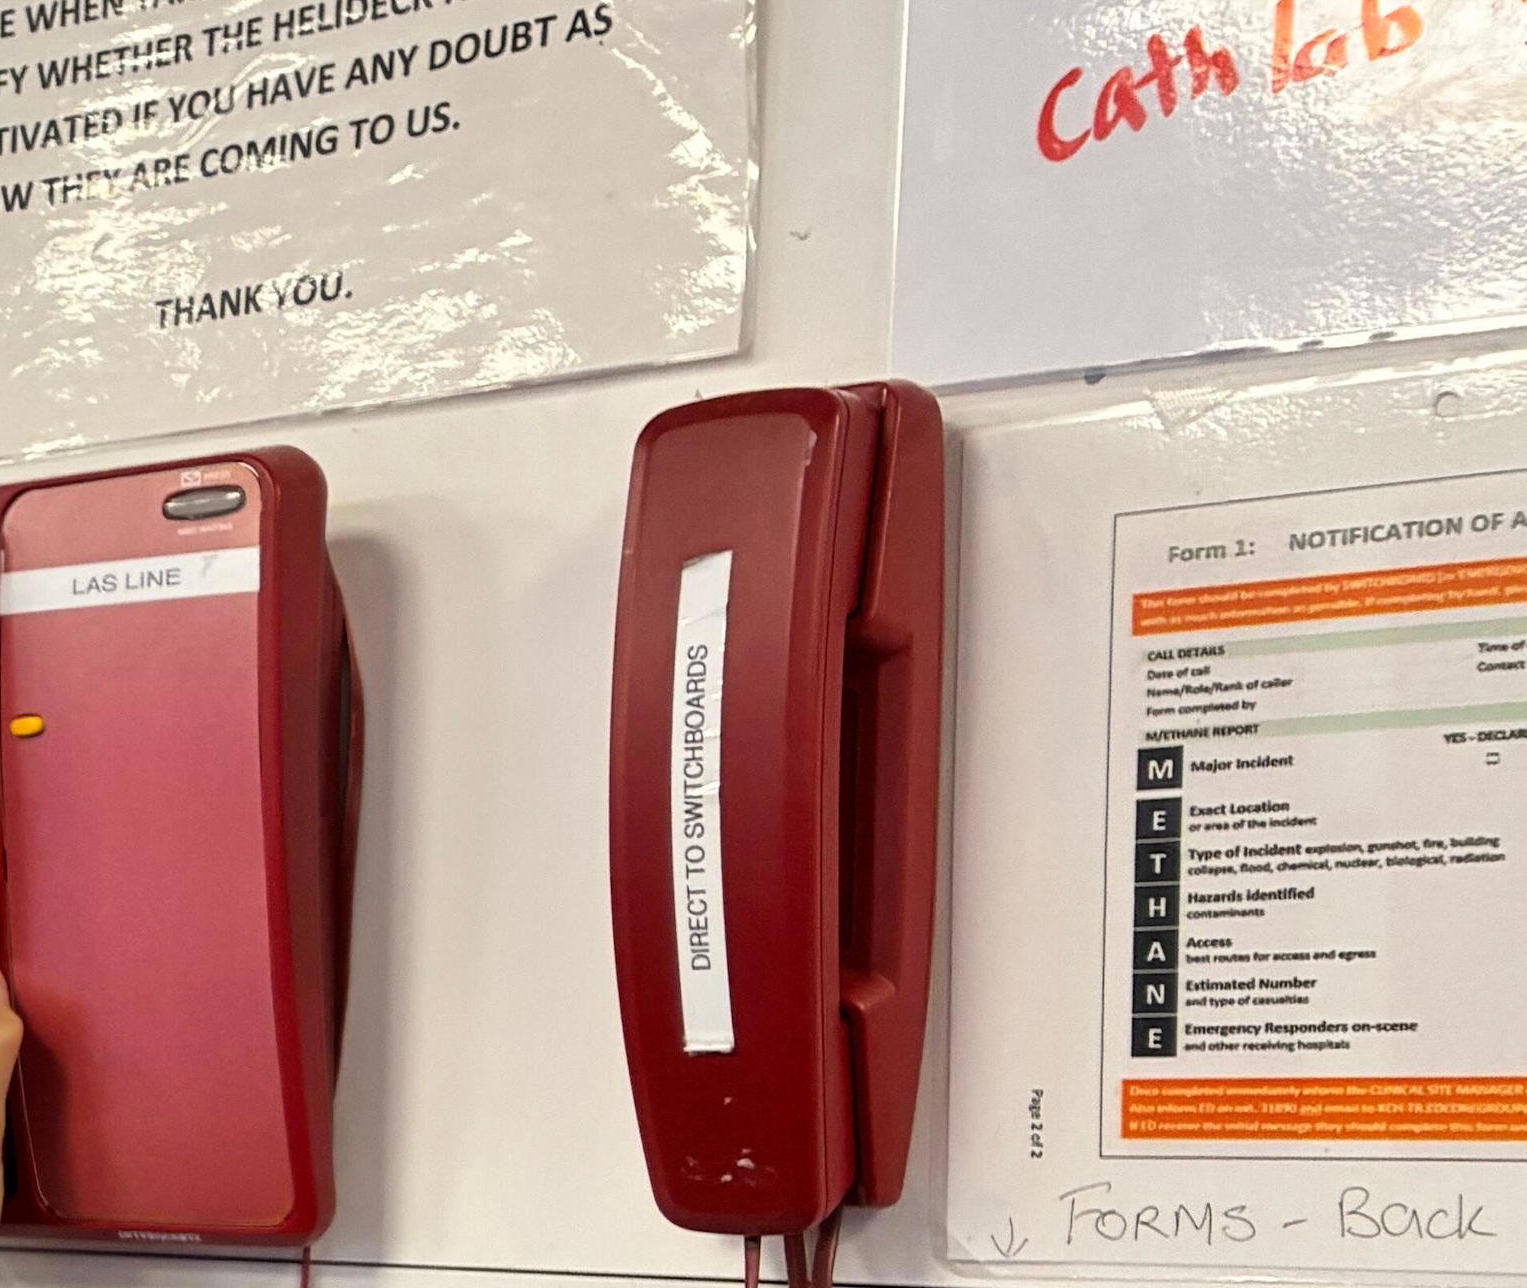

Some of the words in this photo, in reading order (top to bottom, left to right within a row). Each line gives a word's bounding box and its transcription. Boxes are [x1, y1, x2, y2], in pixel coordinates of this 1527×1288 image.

[37, 32, 194, 90] WHETHER
[202, 16, 264, 57] THE
[133, 99, 160, 130] IF
[168, 83, 237, 123] YOU
[246, 62, 336, 110] HAVE
[345, 45, 420, 90] ANY
[429, 14, 559, 72] DOUBT
[565, 3, 614, 42] AS
[1037, 25, 1240, 162] Cath
[1270, 0, 1425, 94] lab
[41, 167, 124, 207] THEY
[131, 153, 191, 189] ARE
[199, 123, 339, 178] COMING
[349, 113, 395, 151] TO
[406, 101, 461, 138] US.
[154, 283, 264, 329] THANK
[272, 271, 353, 309] YOU.
[1289, 516, 1464, 551] NOTIFICATION
[1470, 512, 1505, 534] OF
[1168, 545, 1227, 563] Form
[1234, 538, 1256, 557] 1:
[72, 573, 117, 596] LAS
[125, 567, 182, 591] LINE
[1147, 650, 1175, 662] CALL
[1177, 646, 1226, 660] DETAILS
[1478, 642, 1509, 653] Time
[1147, 669, 1174, 681] Date
[1176, 667, 1189, 678] of
[1191, 665, 1212, 678] call
[1477, 660, 1526, 673] Contact
[1147, 681, 1244, 699] Name/Role/Rank
[1246, 679, 1260, 690] of
[1260, 678, 1294, 690] caller
[1147, 706, 1176, 717] Form
[1178, 700, 1240, 715] completed
[1241, 700, 1257, 712] by
[684, 643, 709, 839] SWITCHBOARDS
[1145, 727, 1210, 743] M/ETHANE
[1212, 723, 1260, 737] REPORT
[1443, 732, 1467, 745] YES
[1148, 758, 1174, 781] M
[1191, 757, 1233, 774] Major
[1235, 755, 1294, 770] Incident
[1189, 804, 1227, 817] Exact
[1230, 800, 1290, 815] Location
[1152, 809, 1167, 832] E
[1204, 822, 1230, 831] area
[1232, 819, 1245, 830] of
[1247, 818, 1267, 829] the
[1269, 815, 1318, 828] incident
[1187, 848, 1222, 862] Type
[1224, 845, 1241, 859] of
[1243, 843, 1302, 858] Incident
[1449, 836, 1501, 849] building
[1449, 852, 1506, 864] radiation
[685, 844, 706, 879] TO
[1149, 852, 1167, 875] T
[1187, 889, 1243, 904] Hazards
[1246, 886, 1315, 901] identified
[1148, 896, 1167, 919] H
[1186, 908, 1266, 920] contaminants
[687, 888, 711, 971] DIRECT
[1147, 941, 1167, 962] A
[1186, 937, 1233, 948] Access
[1186, 953, 1211, 964] best
[1213, 953, 1251, 963] routes
[1253, 951, 1270, 962] for
[1273, 951, 1311, 961] access
[1313, 950, 1336, 960] and
[1338, 950, 1377, 962] egress
[1146, 984, 1166, 1005] N
[1185, 978, 1255, 991] Estimated
[1258, 977, 1317, 991] Number
[1185, 995, 1207, 1006] and
[1209, 996, 1236, 1008] type
[1237, 995, 1251, 1006] of
[1252, 994, 1310, 1005] casualties
[1148, 1028, 1164, 1050] E
[1184, 1023, 1261, 1037] Emergency
[1265, 1020, 1349, 1036] Responders
[1351, 1020, 1419, 1033] on-scene
[1184, 1040, 1206, 1052] and
[1208, 1039, 1241, 1051] other
[1242, 1039, 1296, 1053] receiving
[1297, 1038, 1351, 1052] hospitals
[1029, 1088, 1044, 1120] Page
[1059, 1181, 1257, 1246] FORMS
[1338, 1186, 1498, 1241] Back
